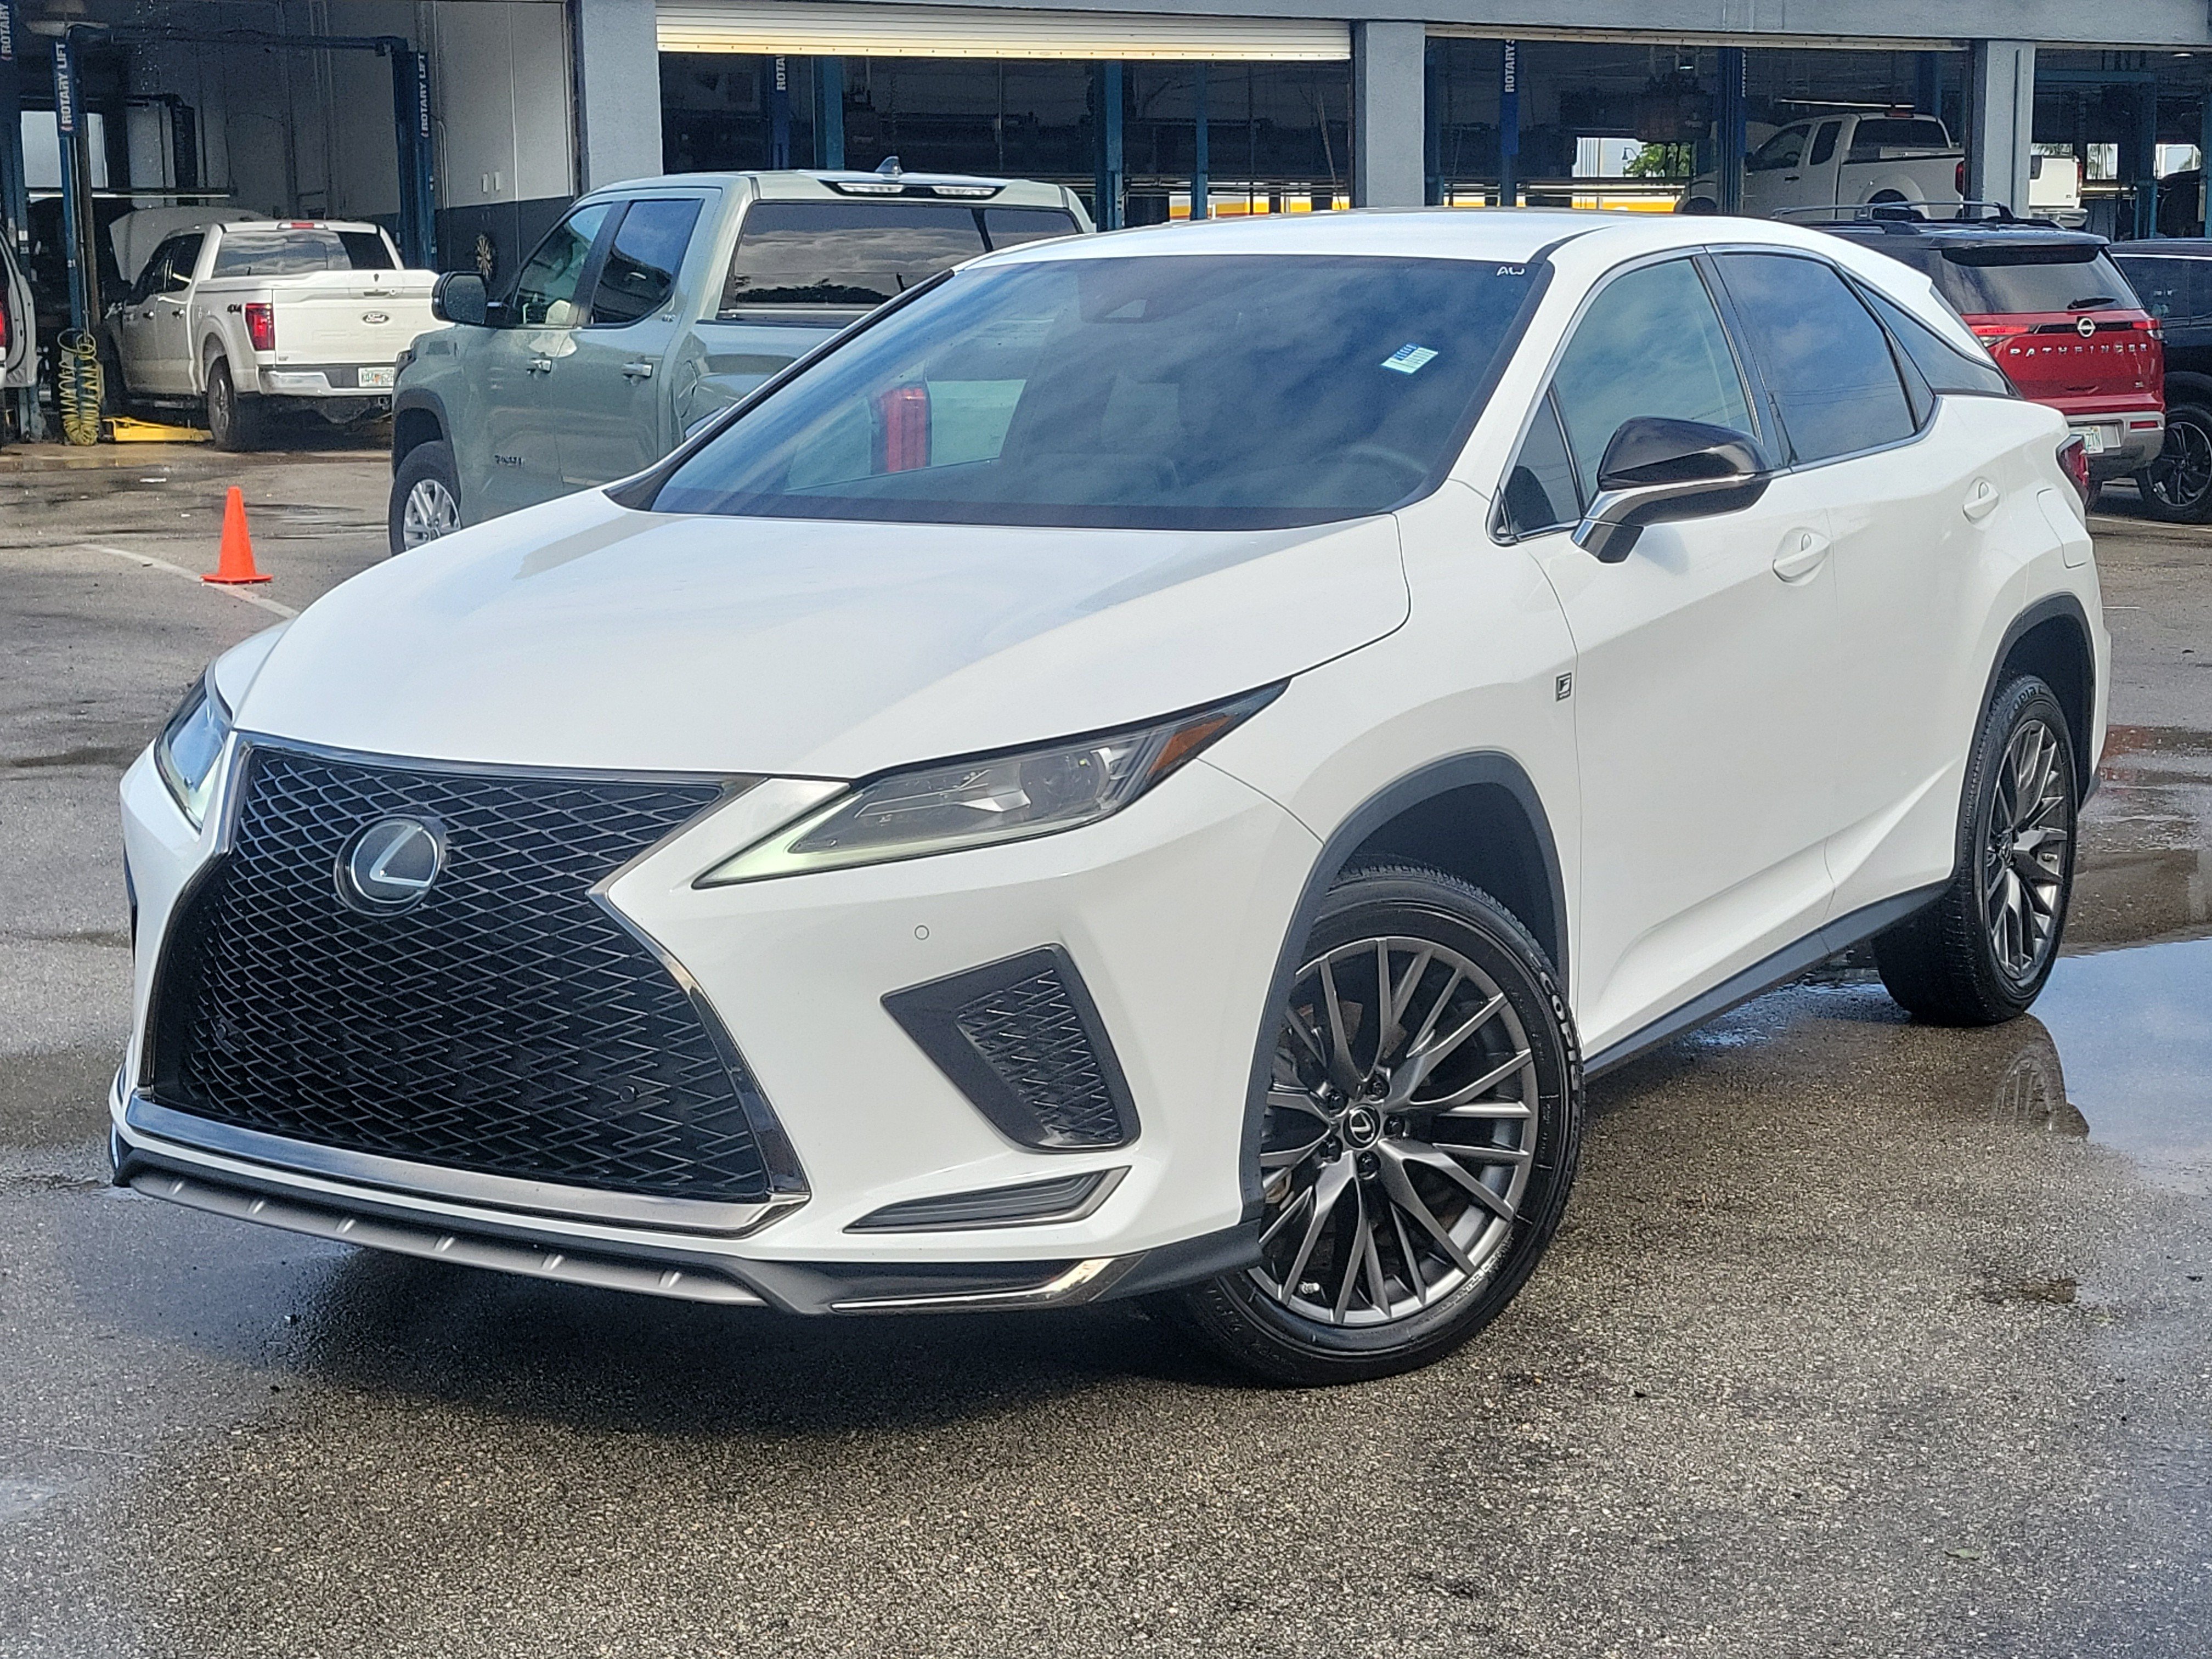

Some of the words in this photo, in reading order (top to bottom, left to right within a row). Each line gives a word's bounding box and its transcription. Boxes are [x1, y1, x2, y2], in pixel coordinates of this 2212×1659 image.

[56, 41, 67, 69] LIFT
[418, 53, 426, 78] LIFT
[1505, 44, 1515, 92] ROTARY
[58, 72, 72, 124] ROTARY
[420, 82, 428, 131] ROTARY
[1497, 266, 1525, 276] AW
[2010, 343, 2147, 357] PATHFINDER
